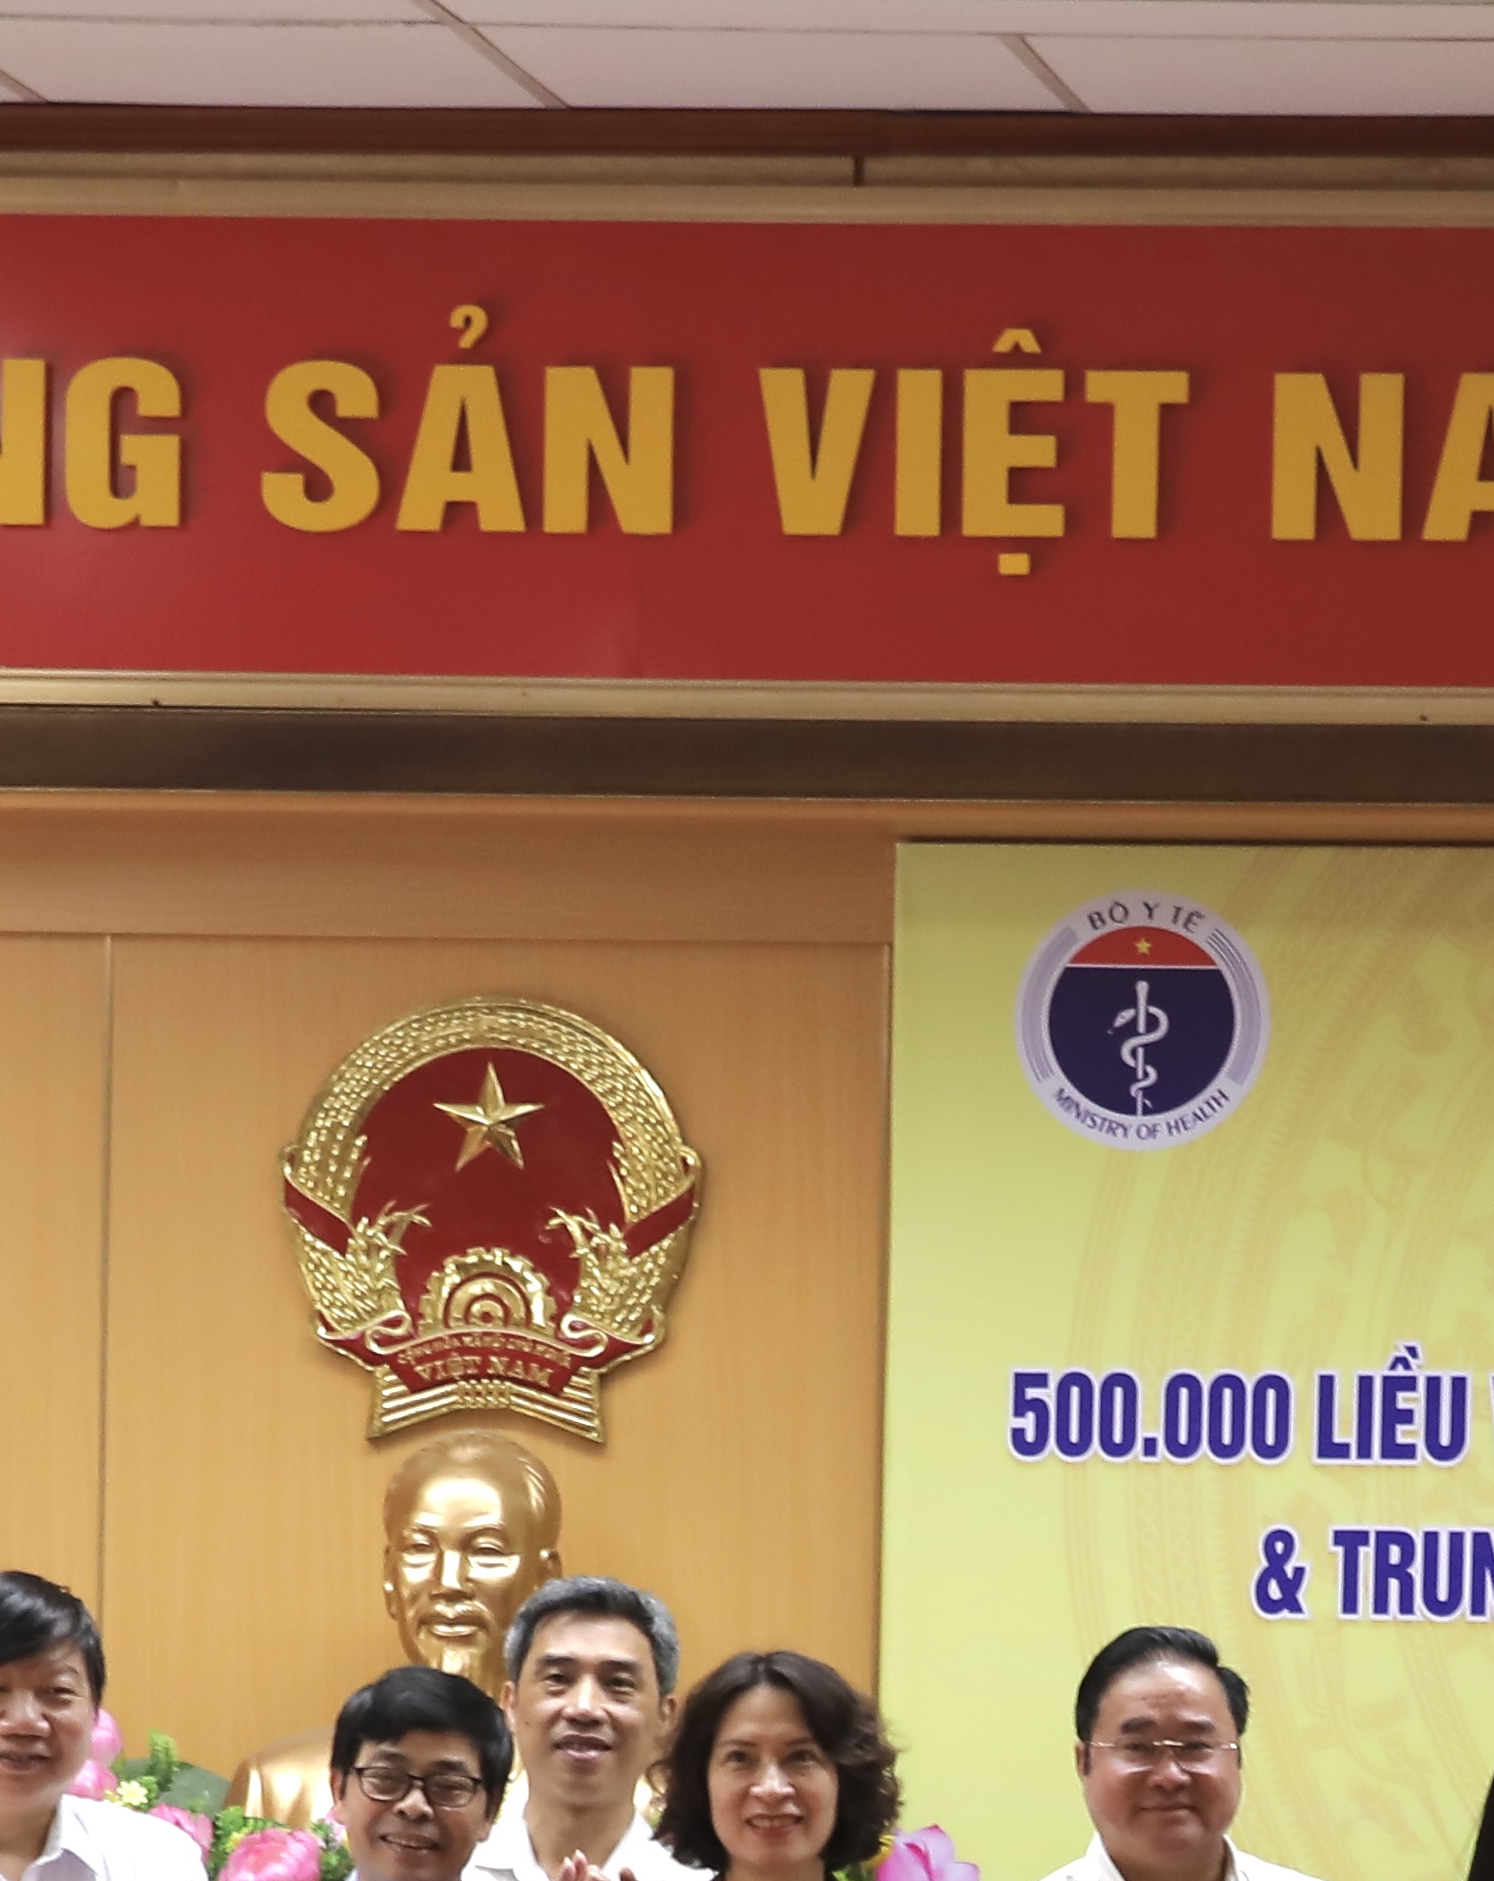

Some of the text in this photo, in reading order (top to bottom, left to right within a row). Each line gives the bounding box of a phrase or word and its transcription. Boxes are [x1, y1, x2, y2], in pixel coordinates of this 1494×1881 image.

[262, 305, 673, 534] SẢN
[760, 329, 1188, 574] VIỆT
[1142, 900, 1160, 921] Y
[1054, 1086, 1231, 1141] MINISTRY OF HEALTH
[487, 1356, 554, 1388] NAM
[1012, 1372, 1290, 1459] 500.000
[1317, 1346, 1466, 1461] LIỀU
[1256, 1529, 1305, 1614] &
